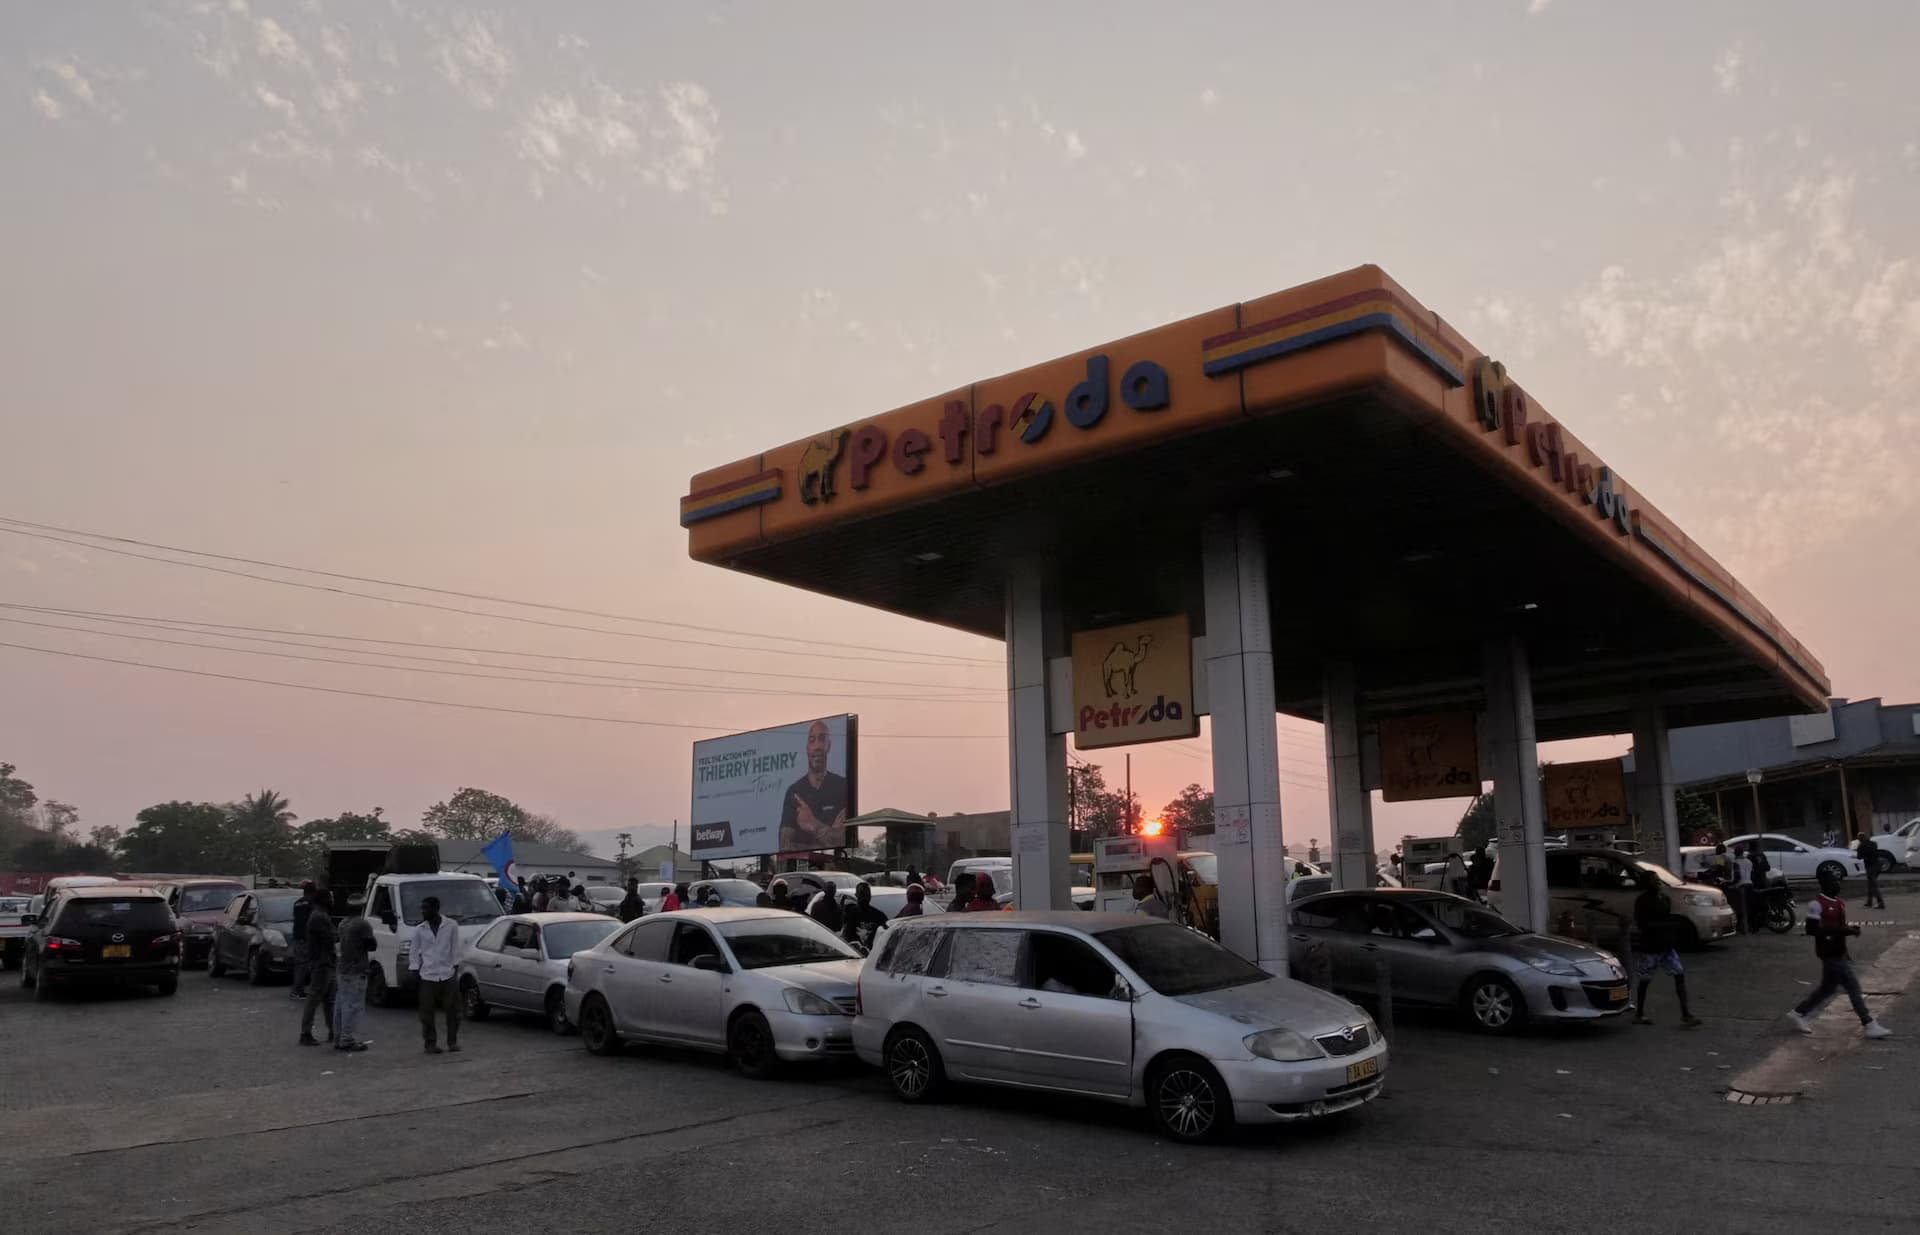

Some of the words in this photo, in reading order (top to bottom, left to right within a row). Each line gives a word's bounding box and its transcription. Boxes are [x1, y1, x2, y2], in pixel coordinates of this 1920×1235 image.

[849, 353, 1169, 490] Petroda
[1079, 695, 1183, 732] Petroda
[699, 760, 750, 783] THIERRY
[752, 752, 798, 774] HENRY
[696, 829, 726, 842] betway
